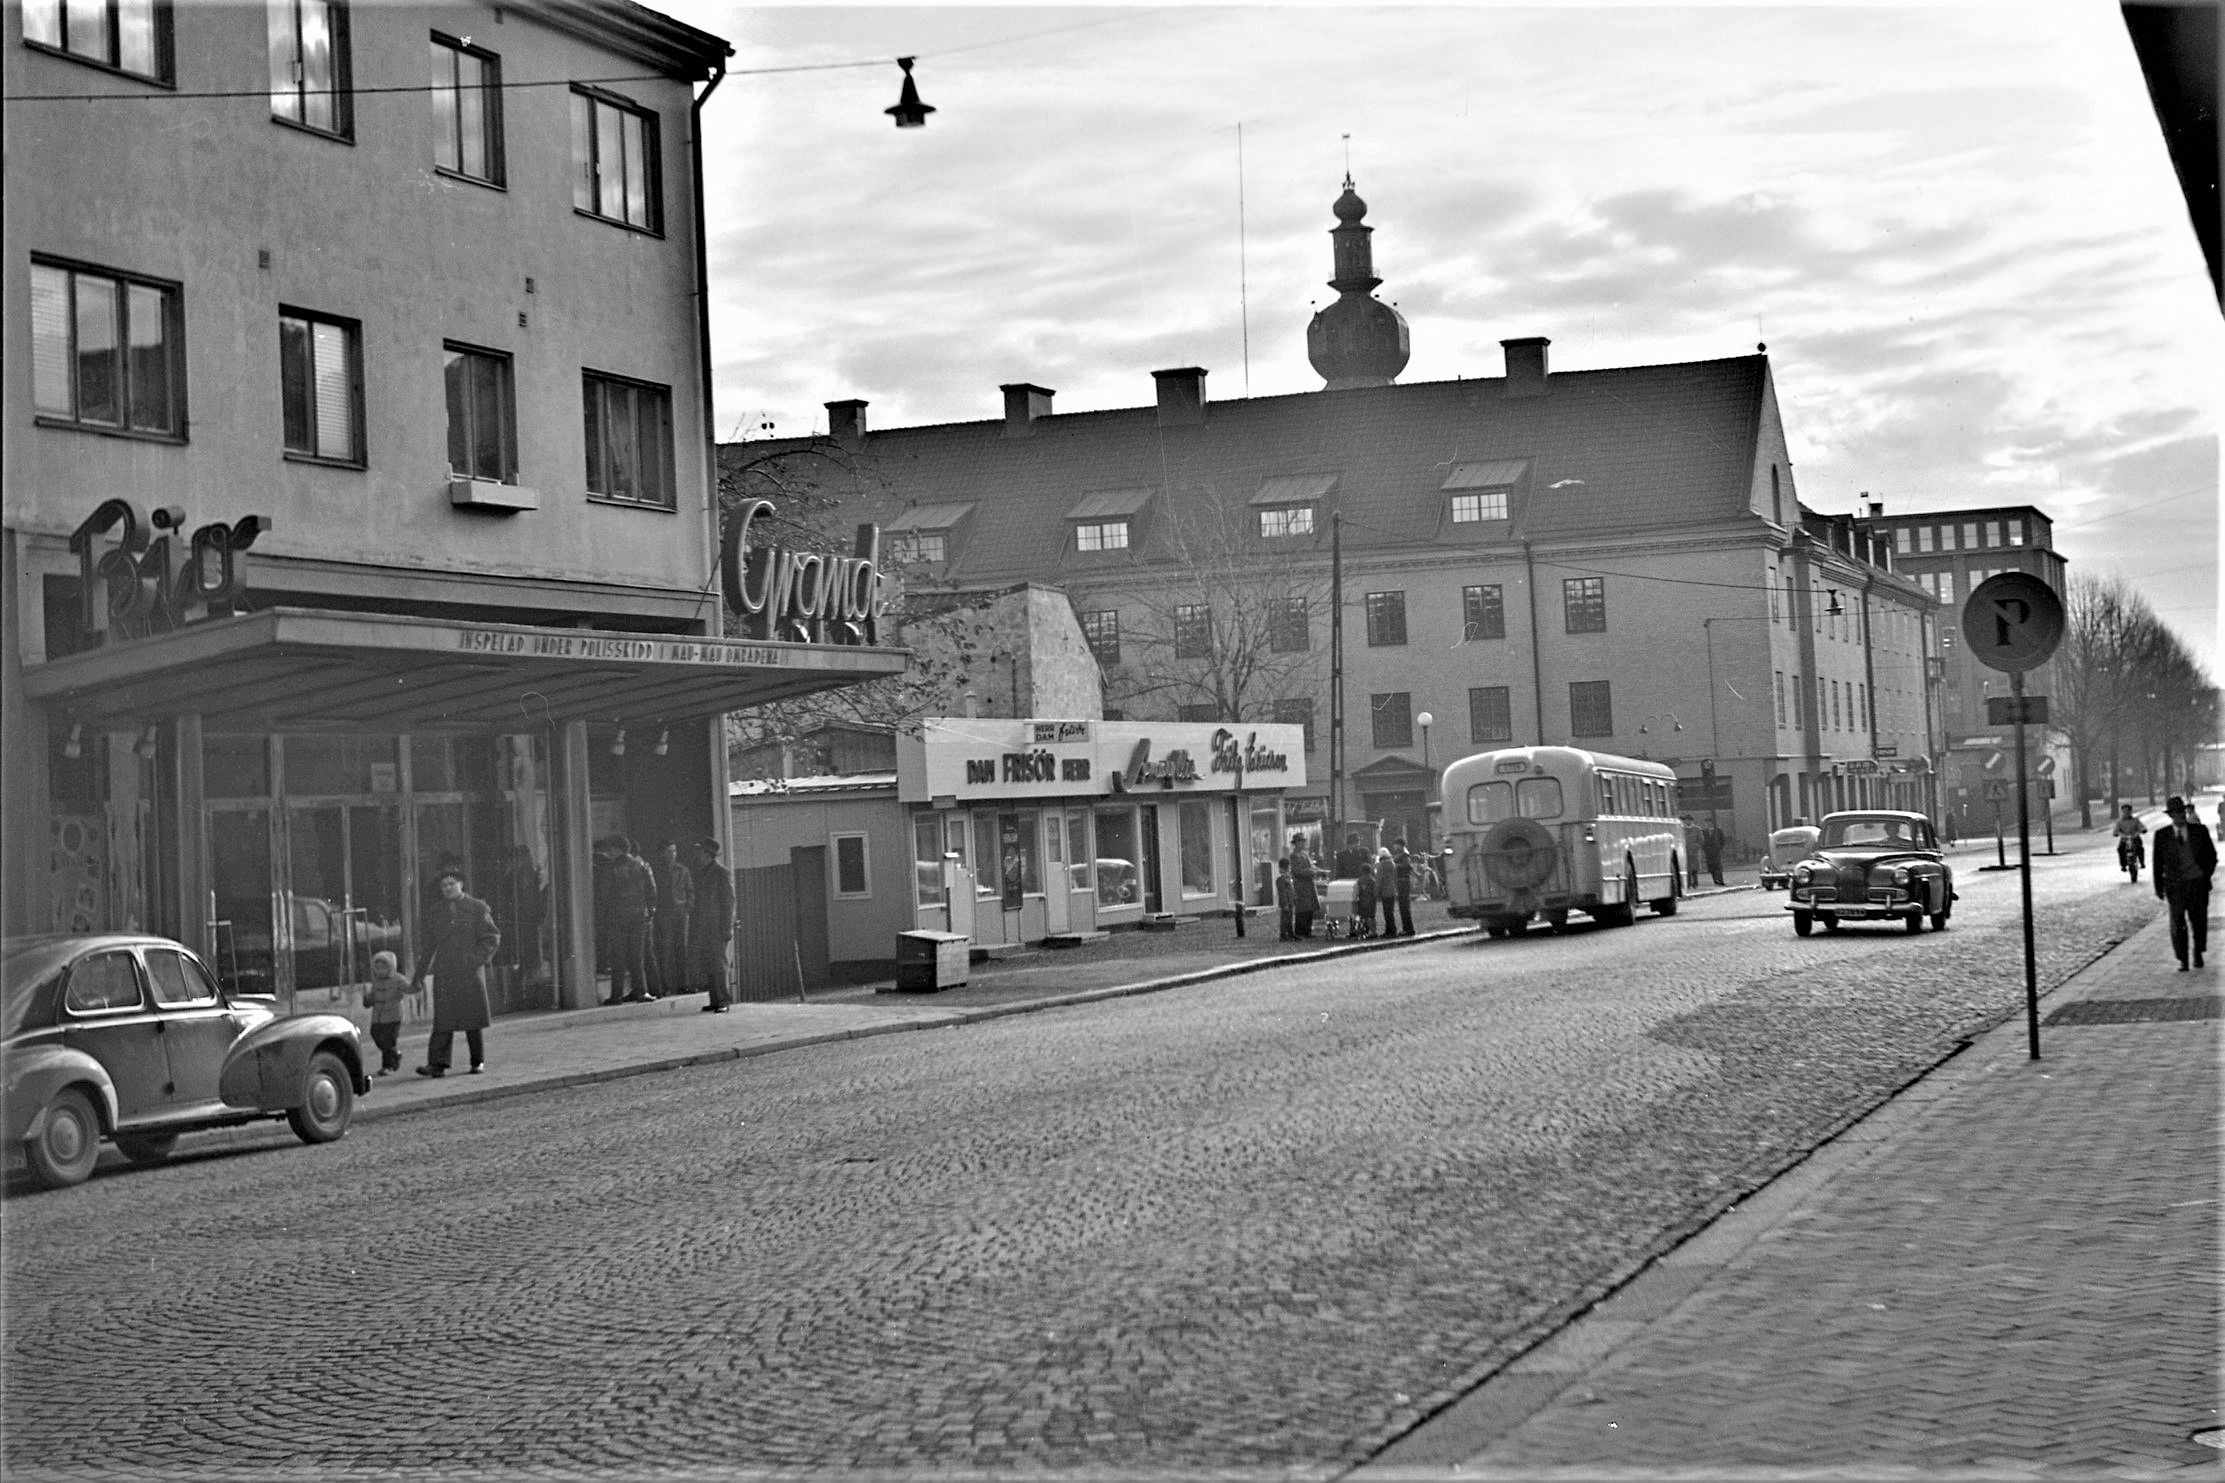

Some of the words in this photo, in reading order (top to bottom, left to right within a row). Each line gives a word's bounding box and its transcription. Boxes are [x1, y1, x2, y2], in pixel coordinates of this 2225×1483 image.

[69, 498, 272, 636] Bio
[720, 498, 888, 642] Grand
[459, 631, 525, 652] INSPELAD
[534, 636, 572, 655] UNDER
[1994, 598, 2031, 646] P
[966, 759, 995, 784] DAM
[1002, 748, 1055, 783] FRISÖR
